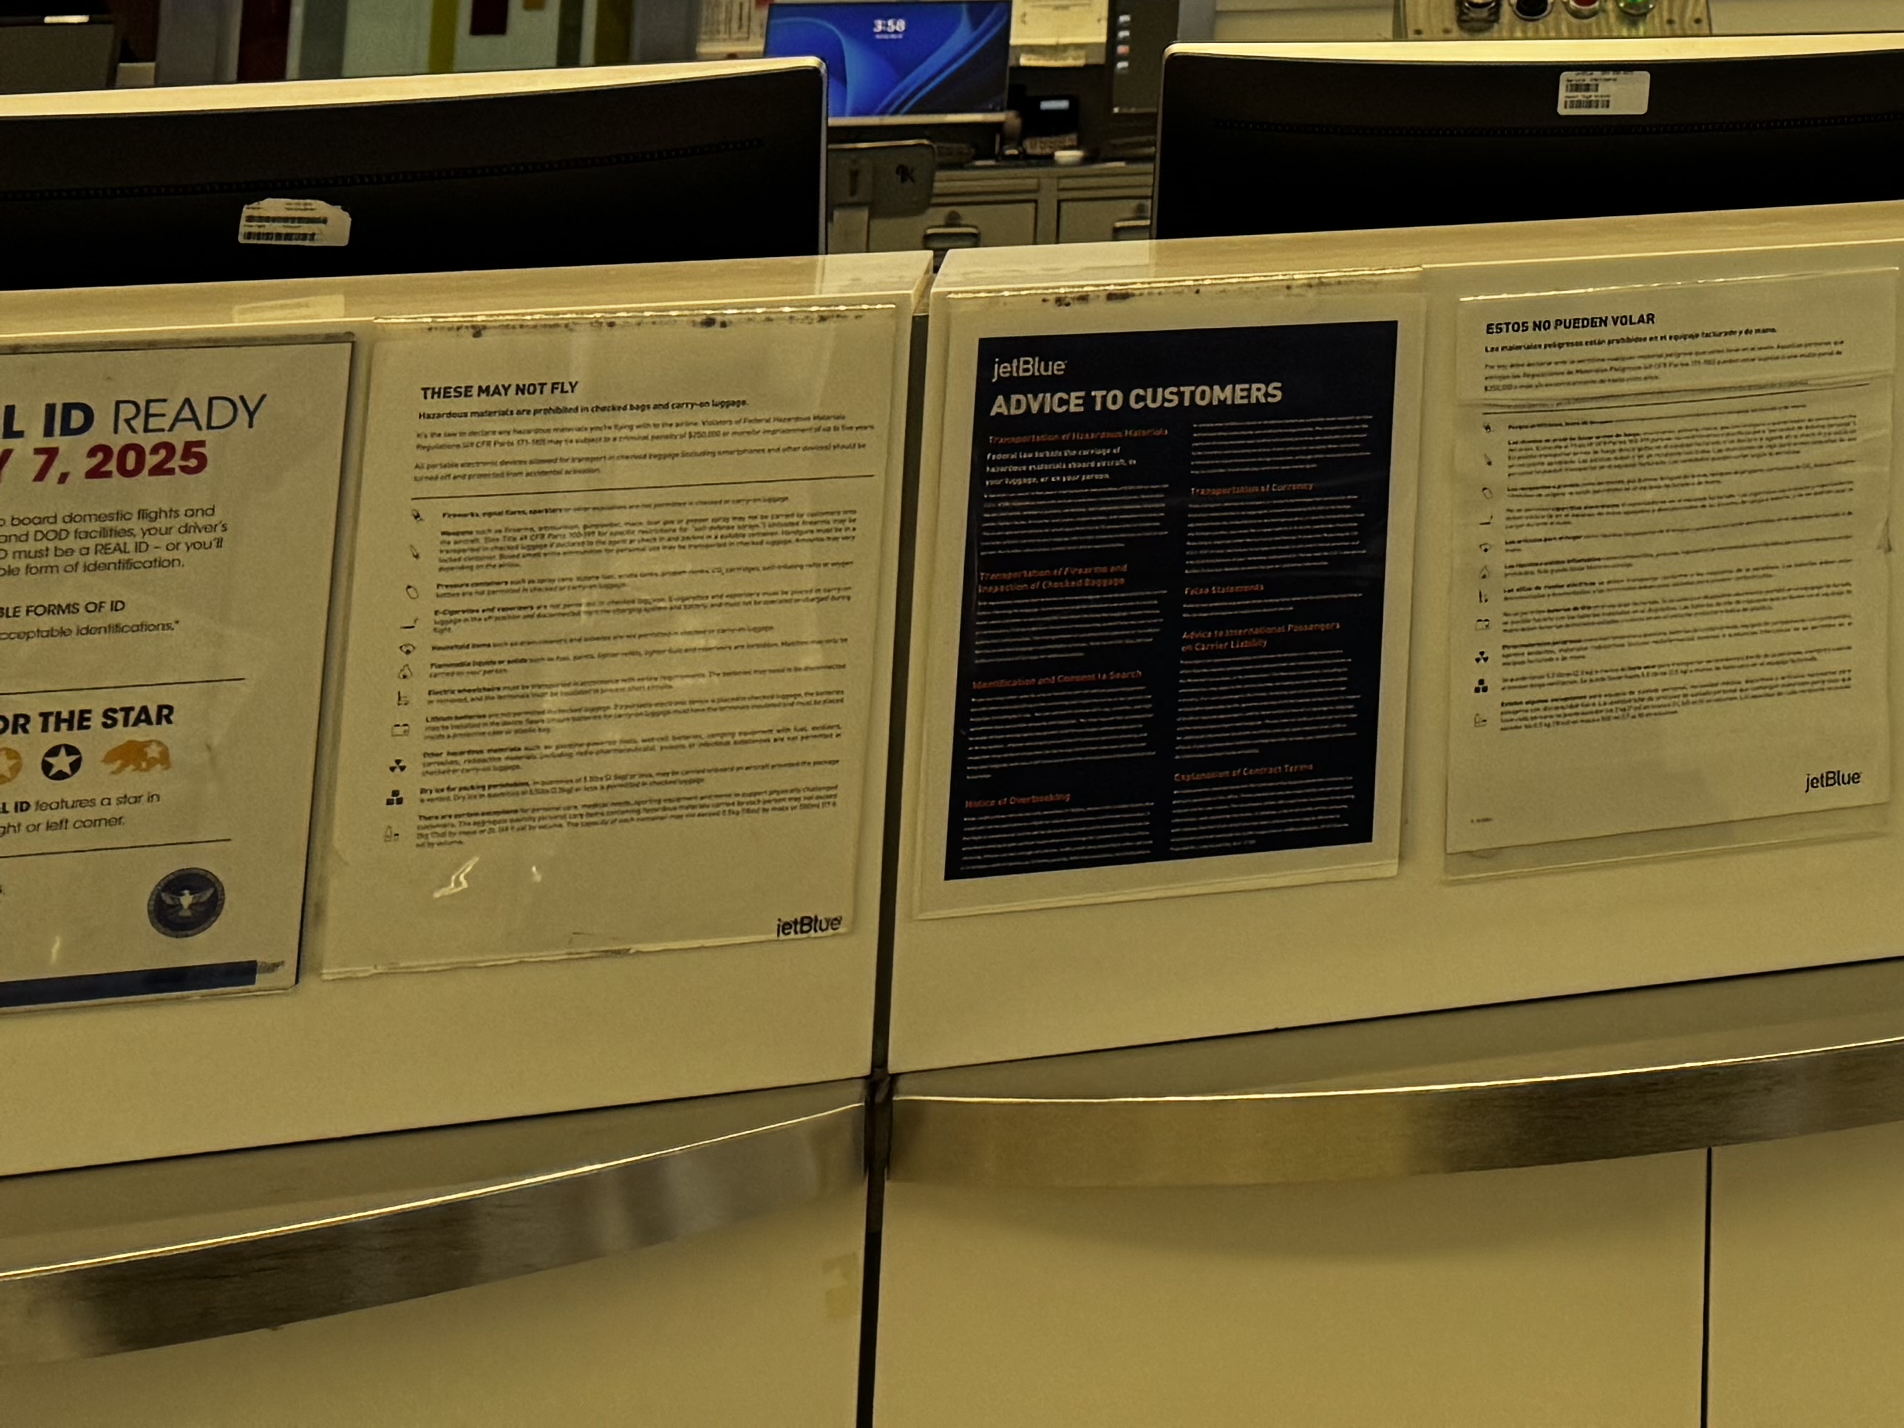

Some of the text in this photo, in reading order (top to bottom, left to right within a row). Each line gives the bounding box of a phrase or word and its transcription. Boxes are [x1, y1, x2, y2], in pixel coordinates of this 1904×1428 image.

[1486, 313, 1655, 335] ESTOS NO PUEDEN VOLAR
[992, 357, 1065, 382] jetBlue
[421, 381, 579, 400] THESE MAY NOT FLY
[990, 382, 1282, 416] ADVICE TO CUSTOMERS
[43, 402, 94, 437] ID
[114, 394, 267, 434] READY
[419, 399, 749, 420] Hazardous materials are prohibited in checked bags and carry-on luggage.
[32, 446, 70, 485] 7,
[85, 440, 208, 479] 2025
[11, 505, 215, 526] board domestic flights and
[34, 529, 69, 541] DOD
[75, 525, 136, 540] facilities,
[141, 525, 173, 537] your
[179, 521, 228, 534] driver's
[13, 537, 223, 559] must be a REAL ID or you'll
[25, 557, 185, 575] form of identification.
[26, 603, 80, 617] FORMS
[85, 601, 105, 613] OF
[111, 600, 125, 612] ID
[39, 709, 92, 732] THE
[101, 704, 174, 729] STAR
[1804, 769, 1861, 792] jetBlue
[14, 792, 160, 813] ID features a star in
[26, 823, 40, 833] or
[46, 818, 68, 832] left
[776, 915, 842, 937] jetBlue
